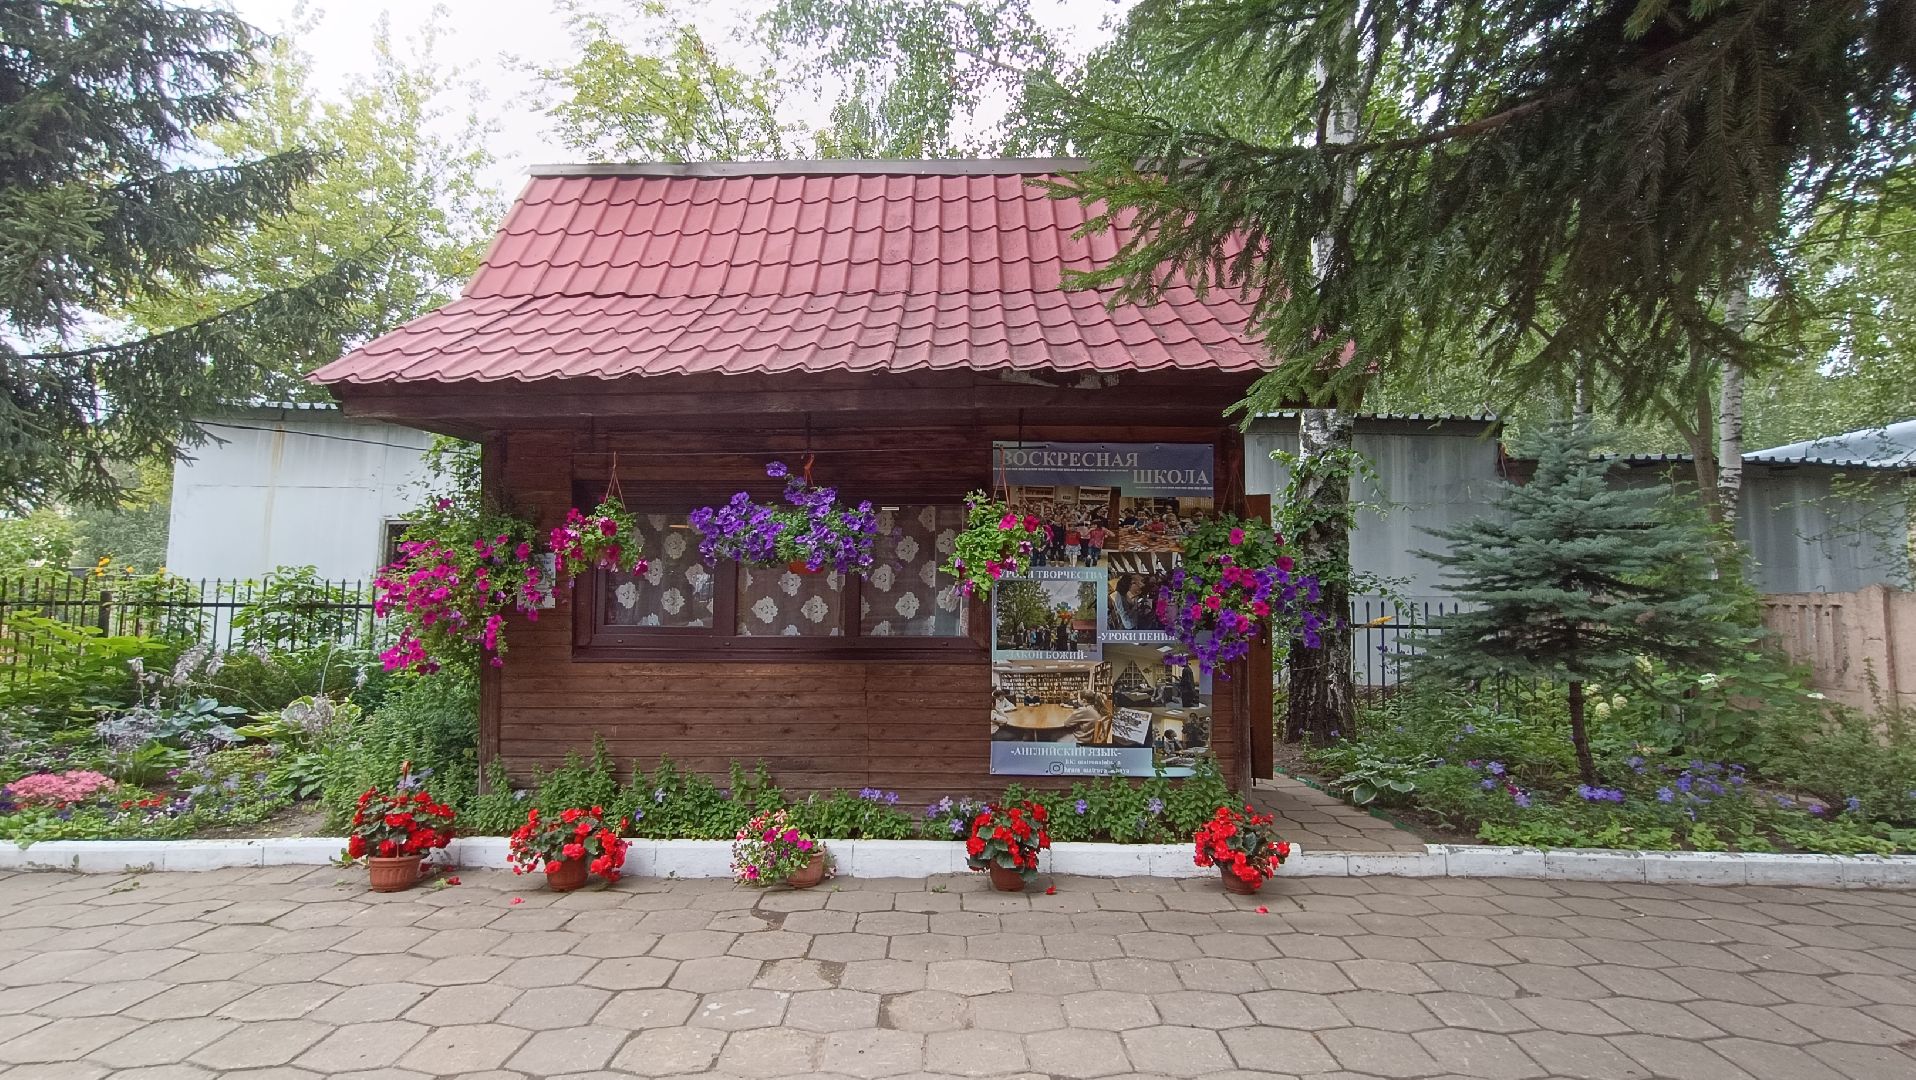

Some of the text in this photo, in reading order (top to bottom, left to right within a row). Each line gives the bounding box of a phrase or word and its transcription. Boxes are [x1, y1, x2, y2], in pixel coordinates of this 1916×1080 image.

[1002, 451, 1138, 467] ВОСКРЕСНАЯ
[1133, 469, 1209, 484] ШКОЛА
[1046, 649, 1087, 660] БОЖИЙ-
[1088, 747, 1121, 757] ЯЗЫК-
